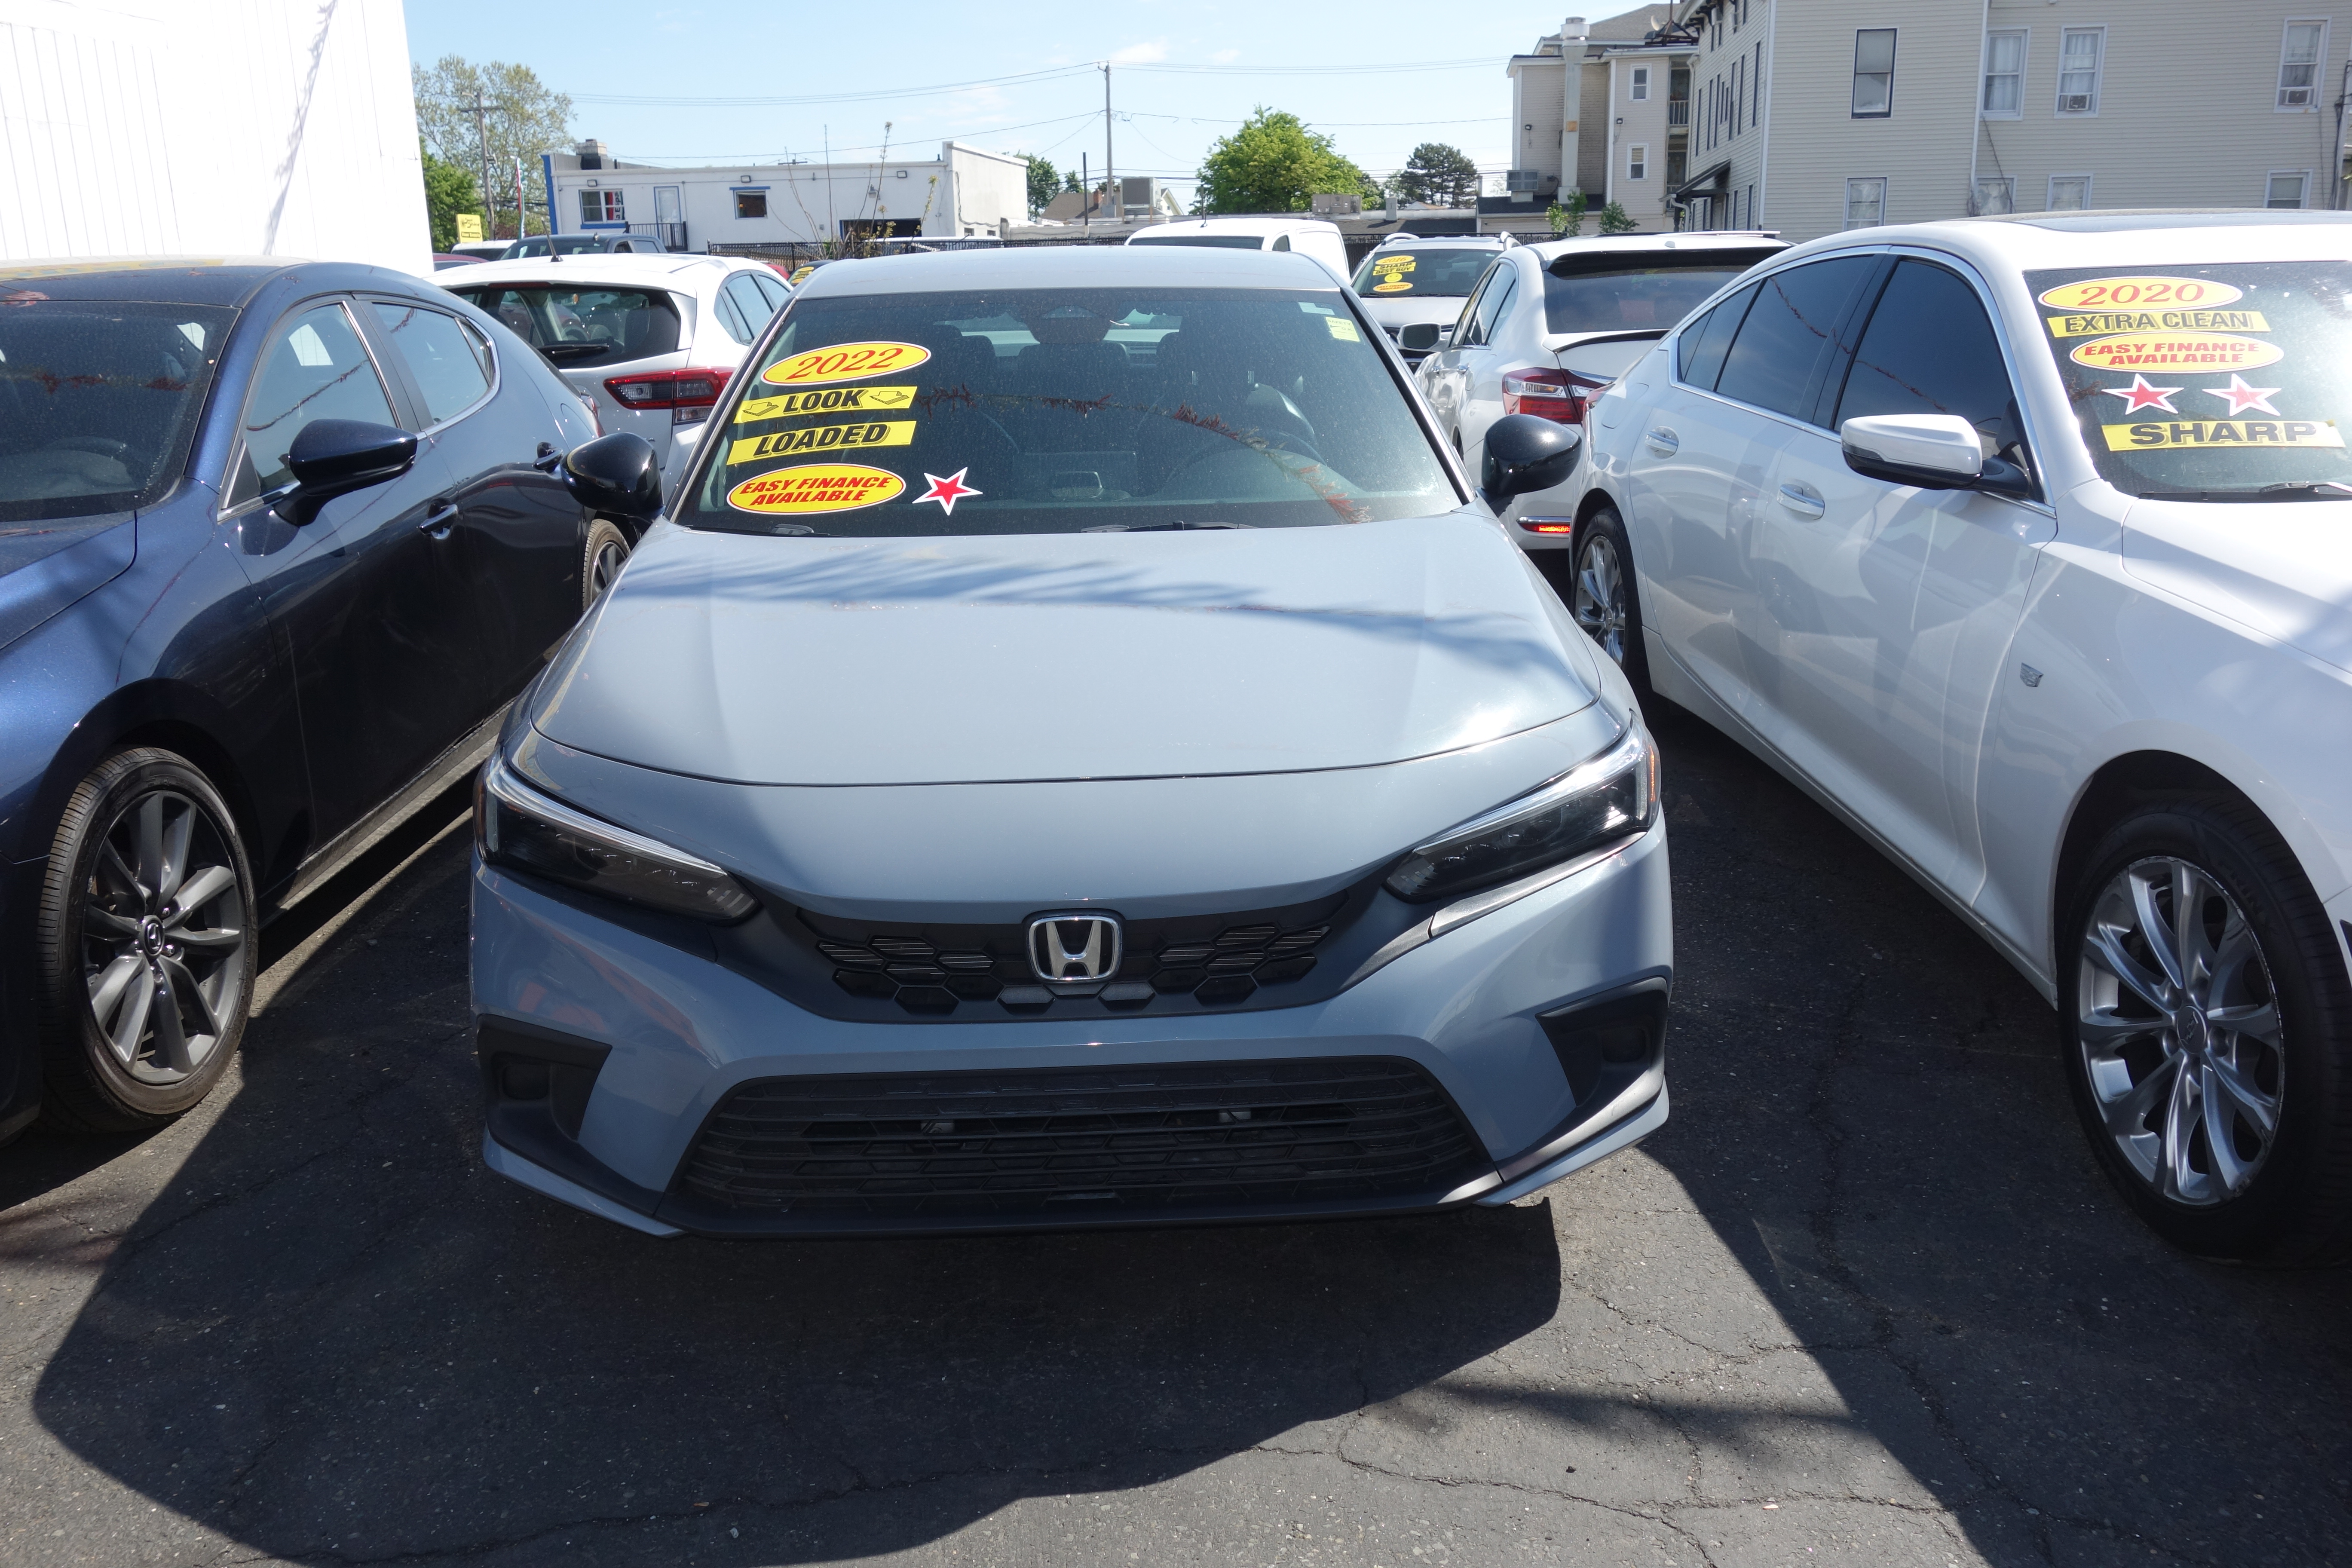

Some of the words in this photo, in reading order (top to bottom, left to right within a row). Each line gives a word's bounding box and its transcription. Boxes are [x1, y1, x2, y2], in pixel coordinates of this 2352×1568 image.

[2077, 284, 2205, 306] 2020
[2065, 313, 2160, 333] EXTRA
[2162, 312, 2252, 328] CLEAN
[2084, 344, 2147, 356] EASY
[2153, 343, 2260, 353] FINANCE
[2108, 353, 2244, 365] AVAILABLE
[785, 348, 903, 380] 2022
[782, 389, 869, 415] LOOK
[753, 424, 890, 457] LOADED
[2130, 422, 2318, 445] SHARP
[739, 478, 798, 494] EASY
[794, 476, 894, 491] FINANCE
[749, 490, 870, 506] AVAILABLE
